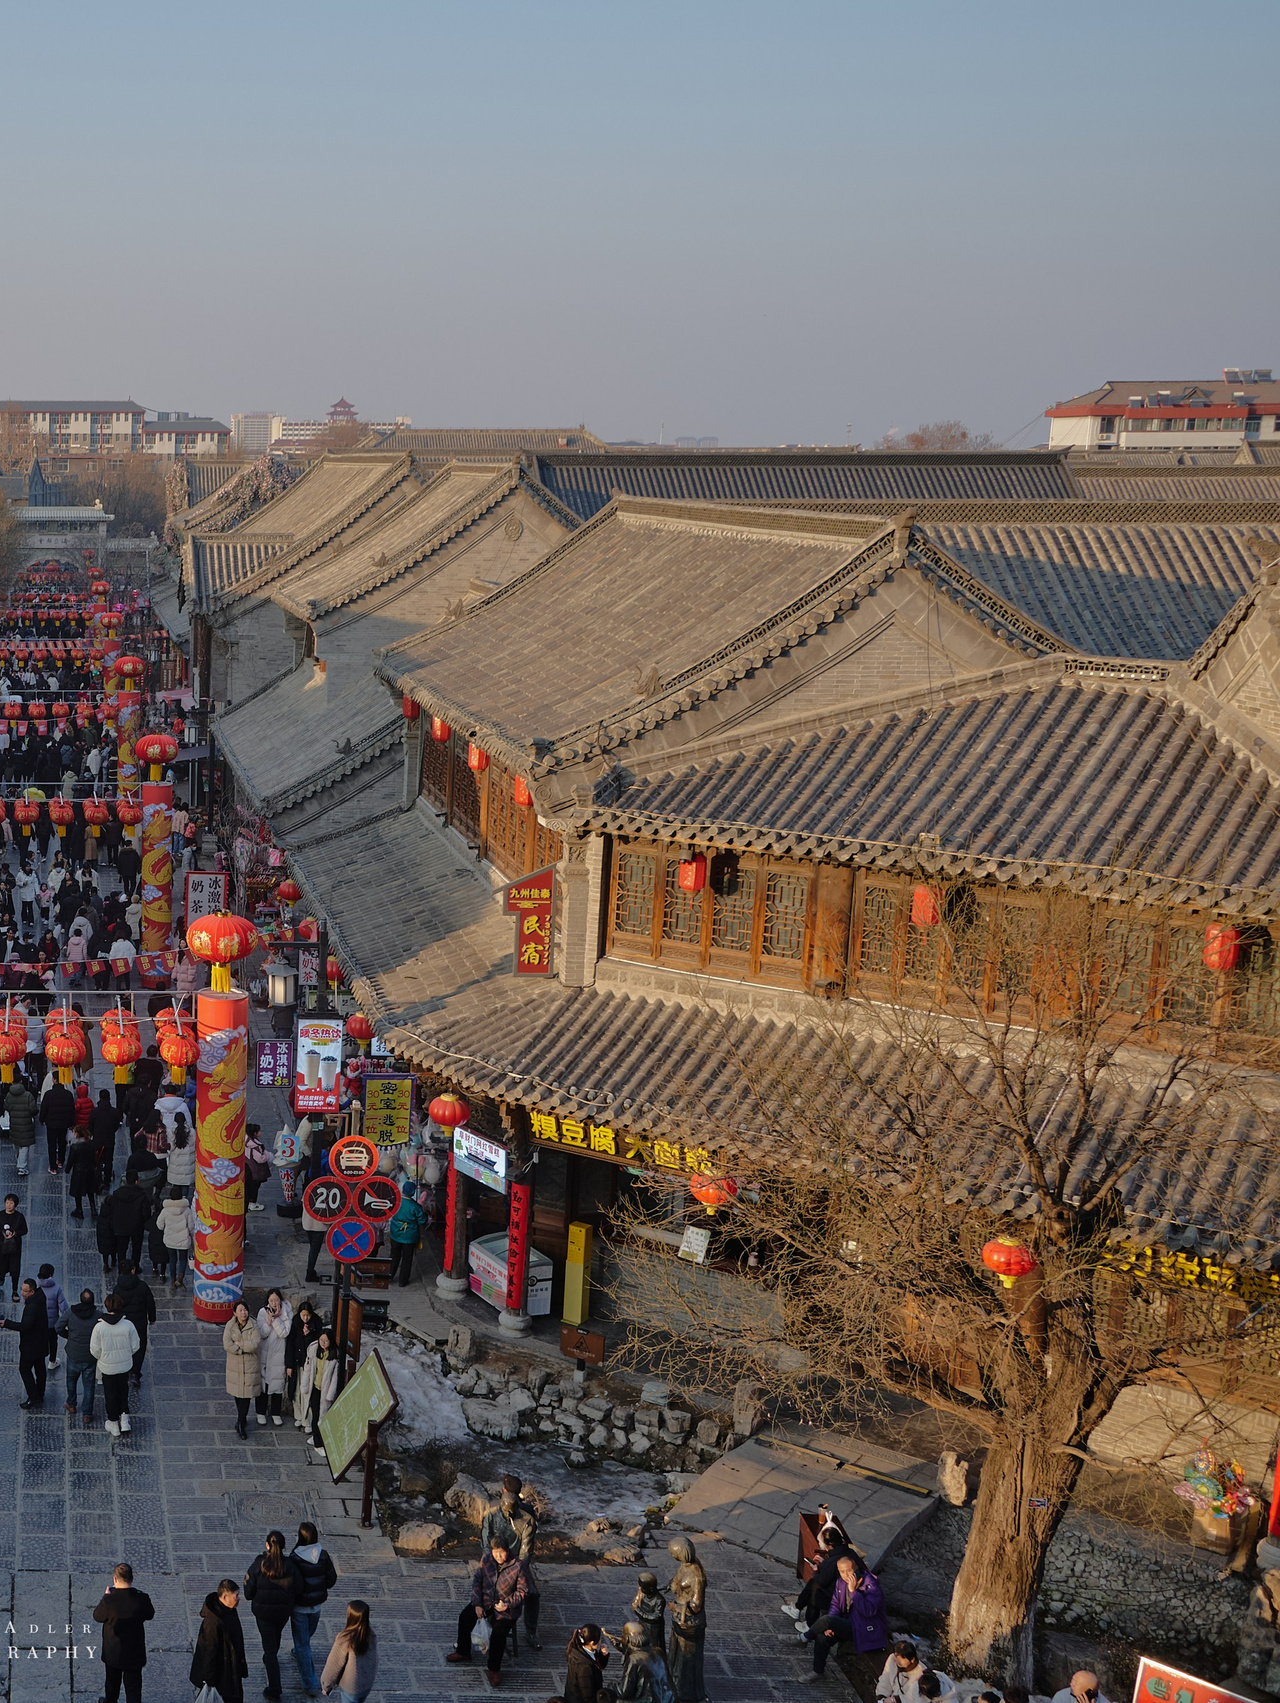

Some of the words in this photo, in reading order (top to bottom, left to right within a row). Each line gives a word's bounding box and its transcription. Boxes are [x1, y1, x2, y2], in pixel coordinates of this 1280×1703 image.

[190, 879, 204, 914] 奶茶
[509, 888, 551, 899] 九州佳泰
[521, 915, 545, 965] 民宿
[260, 1055, 274, 1085] 奶茶
[276, 1042, 289, 1077] 冰淇淋
[274, 1076, 289, 1086] 3元
[378, 1082, 397, 1142] 密室逃脱
[282, 1137, 295, 1158] 3
[315, 1187, 341, 1209] 20
